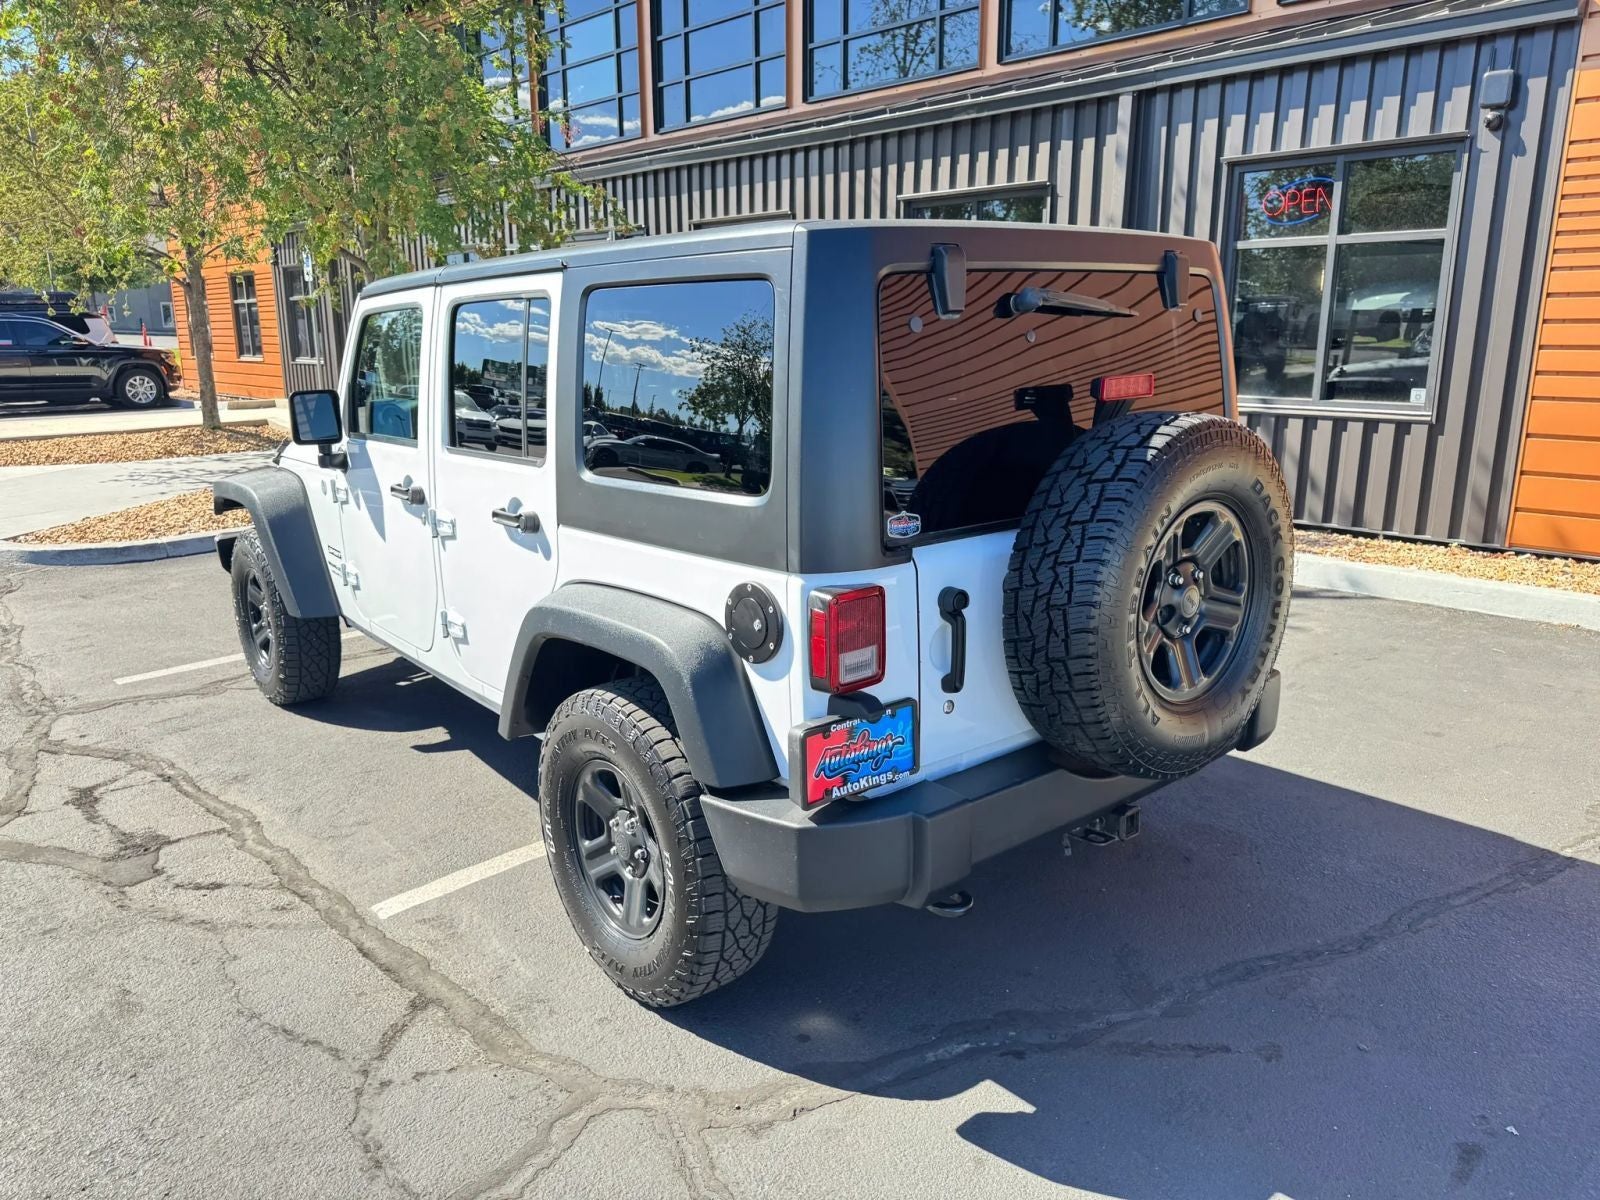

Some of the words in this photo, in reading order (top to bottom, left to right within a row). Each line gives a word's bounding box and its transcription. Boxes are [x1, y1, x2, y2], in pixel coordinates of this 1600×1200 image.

[1262, 188, 1332, 216] OPEN
[1250, 477, 1283, 547] BACK
[1239, 556, 1285, 705] COUNTRY
[831, 770, 910, 799] AutoKings.com
